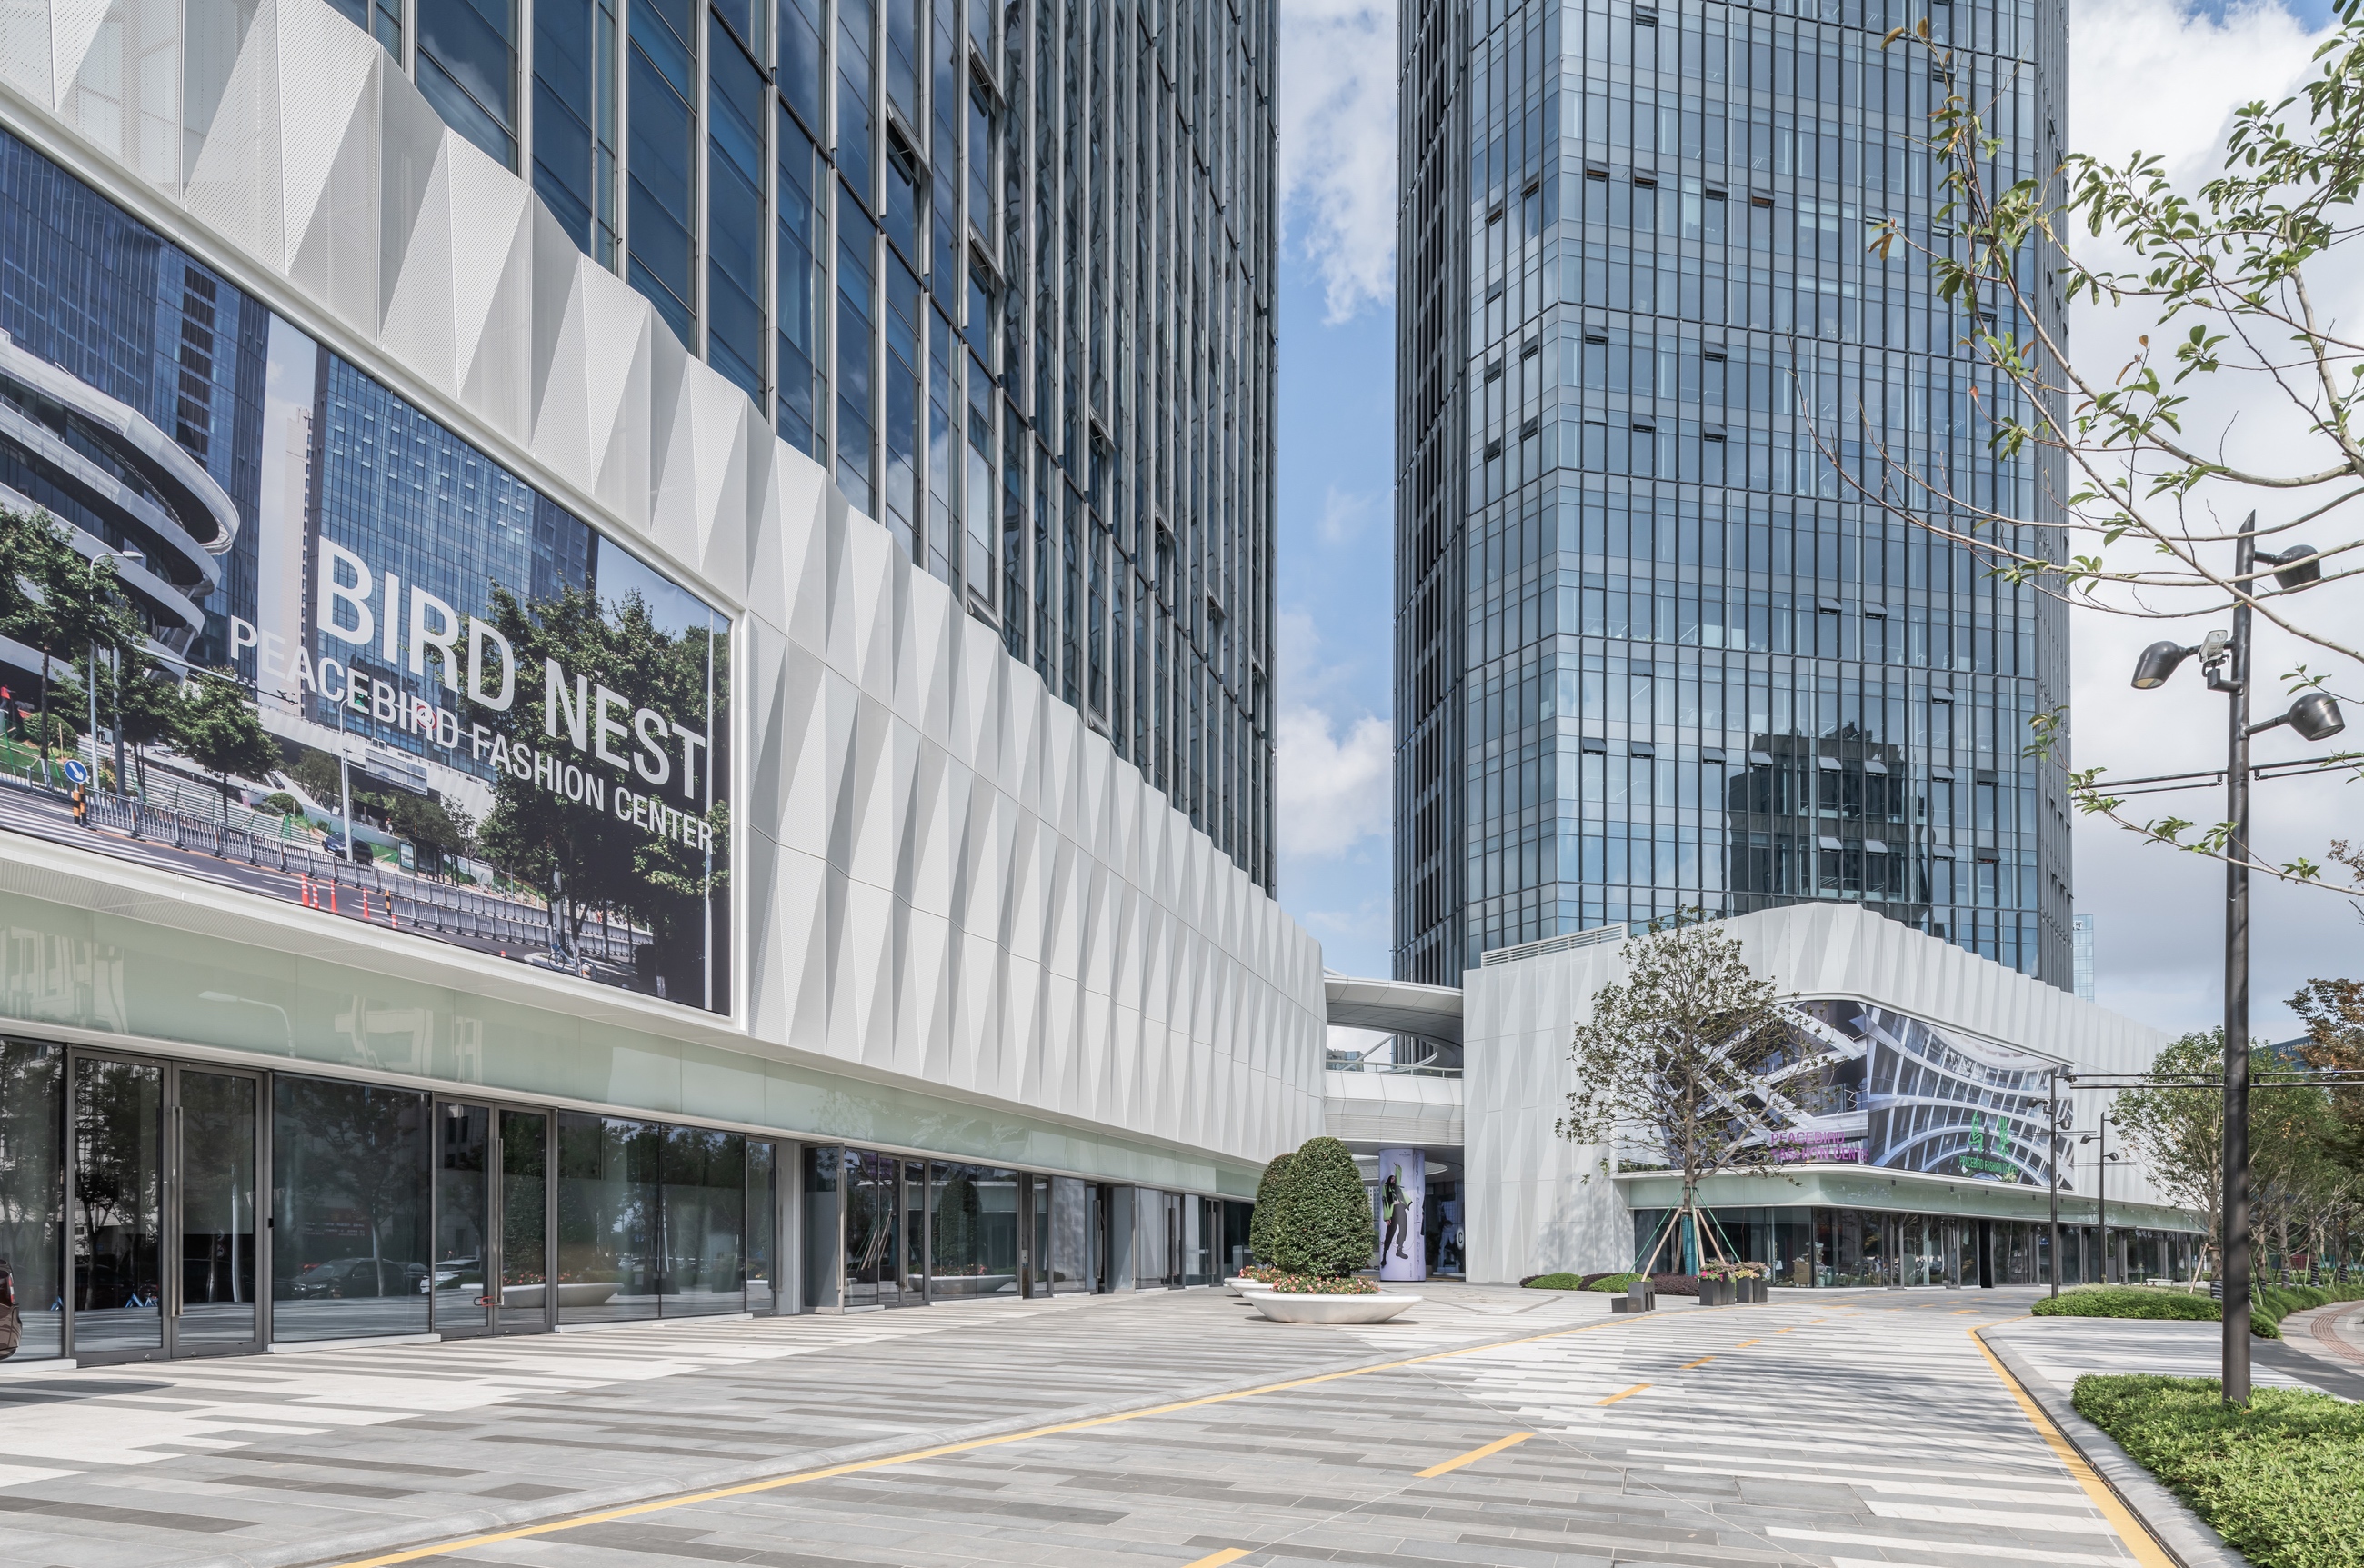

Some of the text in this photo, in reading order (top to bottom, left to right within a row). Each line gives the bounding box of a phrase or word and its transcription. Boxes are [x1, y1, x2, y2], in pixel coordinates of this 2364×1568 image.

[230, 614, 713, 854] PEACEBIRD FASHION CENTER
[317, 535, 706, 800] BIRD NEST
[1770, 1132, 1845, 1145] PEACEBIRD
